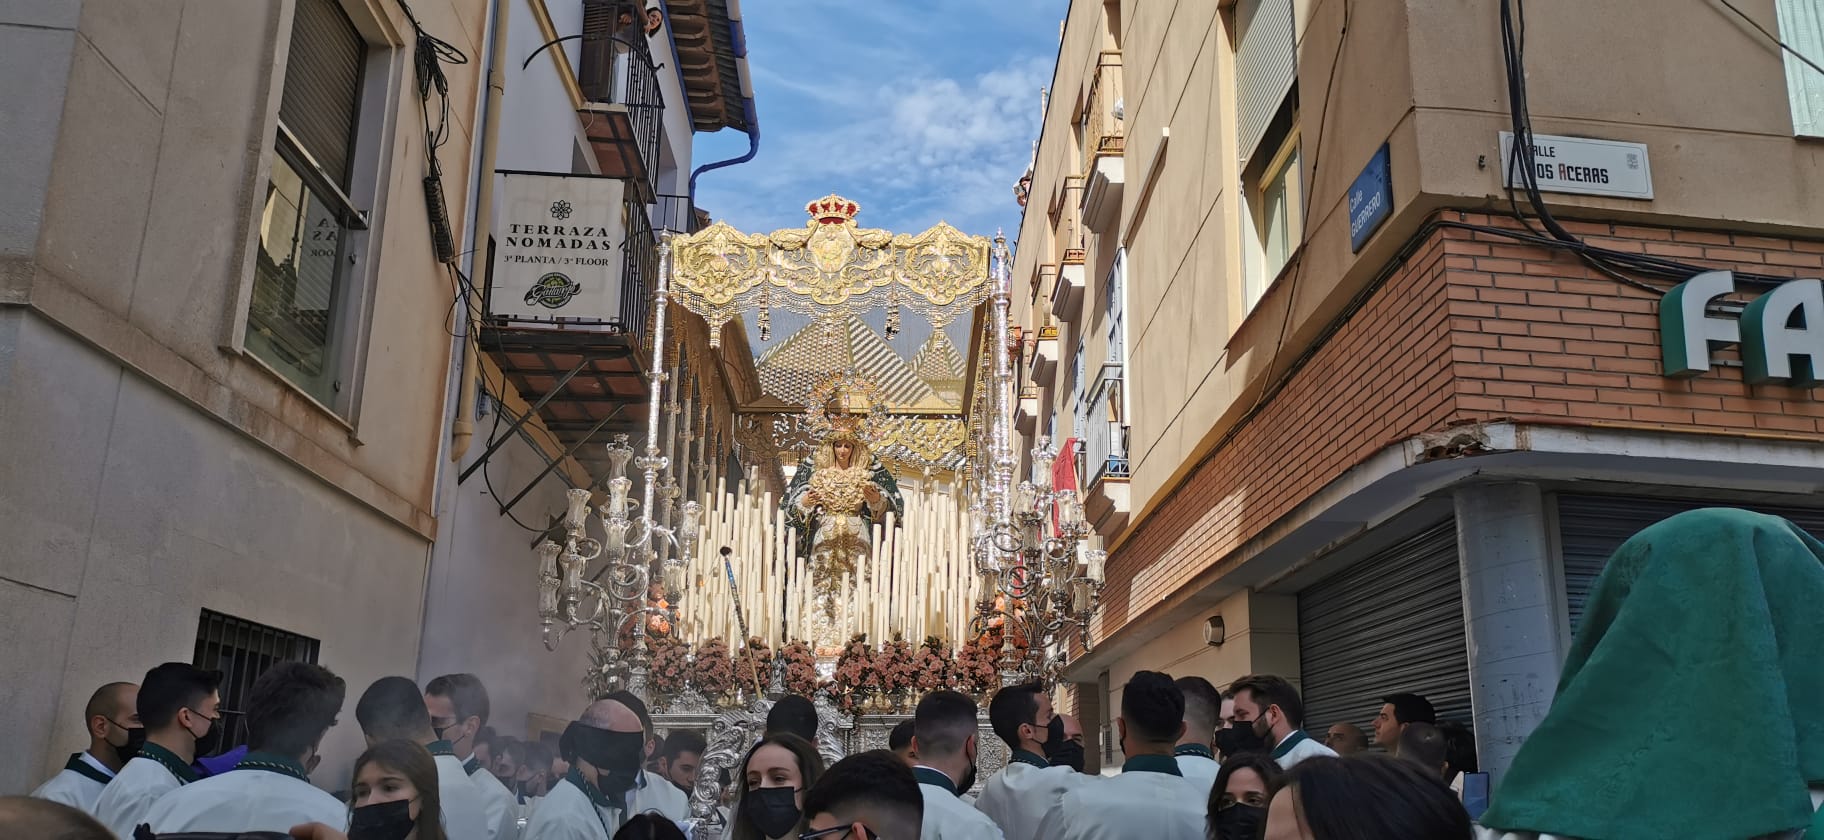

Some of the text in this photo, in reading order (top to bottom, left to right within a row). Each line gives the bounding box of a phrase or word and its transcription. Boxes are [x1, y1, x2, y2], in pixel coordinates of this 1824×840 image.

[1536, 163, 1609, 184] OS ACERAS
[1349, 190, 1363, 213] Calle
[1352, 191, 1381, 238] GUERRERO
[510, 223, 608, 237] TERRAZA
[506, 237, 611, 251] NOMADAS
[515, 255, 556, 265] PLANTA
[575, 257, 609, 267] FLOOR
